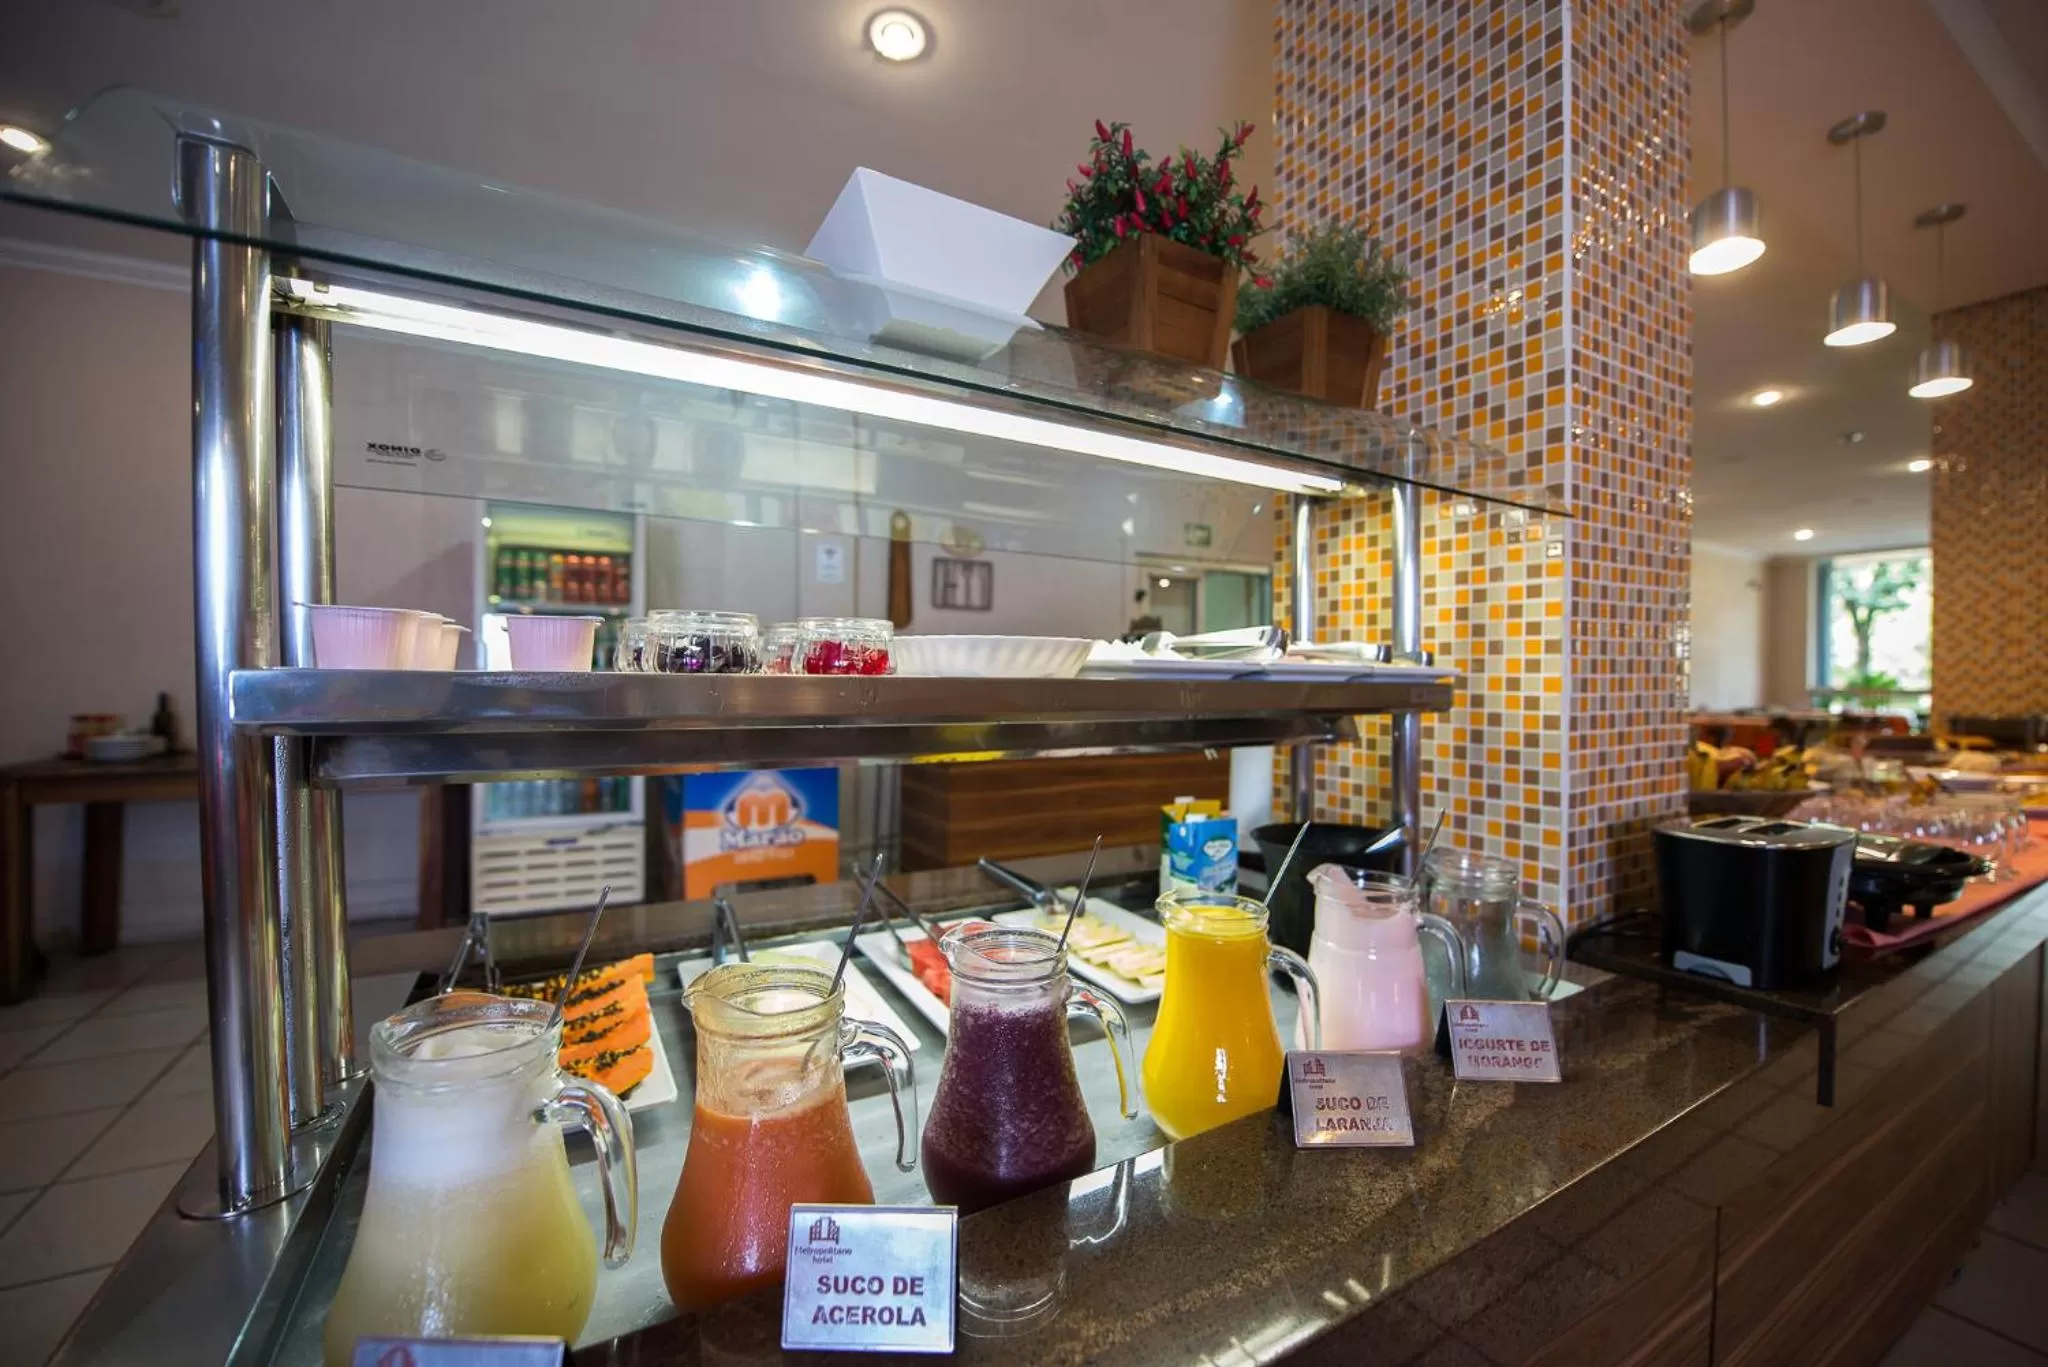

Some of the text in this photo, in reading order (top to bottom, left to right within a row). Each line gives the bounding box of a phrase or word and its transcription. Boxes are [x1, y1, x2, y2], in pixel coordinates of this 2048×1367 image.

[1529, 1039, 1551, 1053] DE
[1315, 1096, 1390, 1111] SUCO DE
[816, 1275, 925, 1296] SUCO DE
[811, 1305, 927, 1327] ACEROLA
